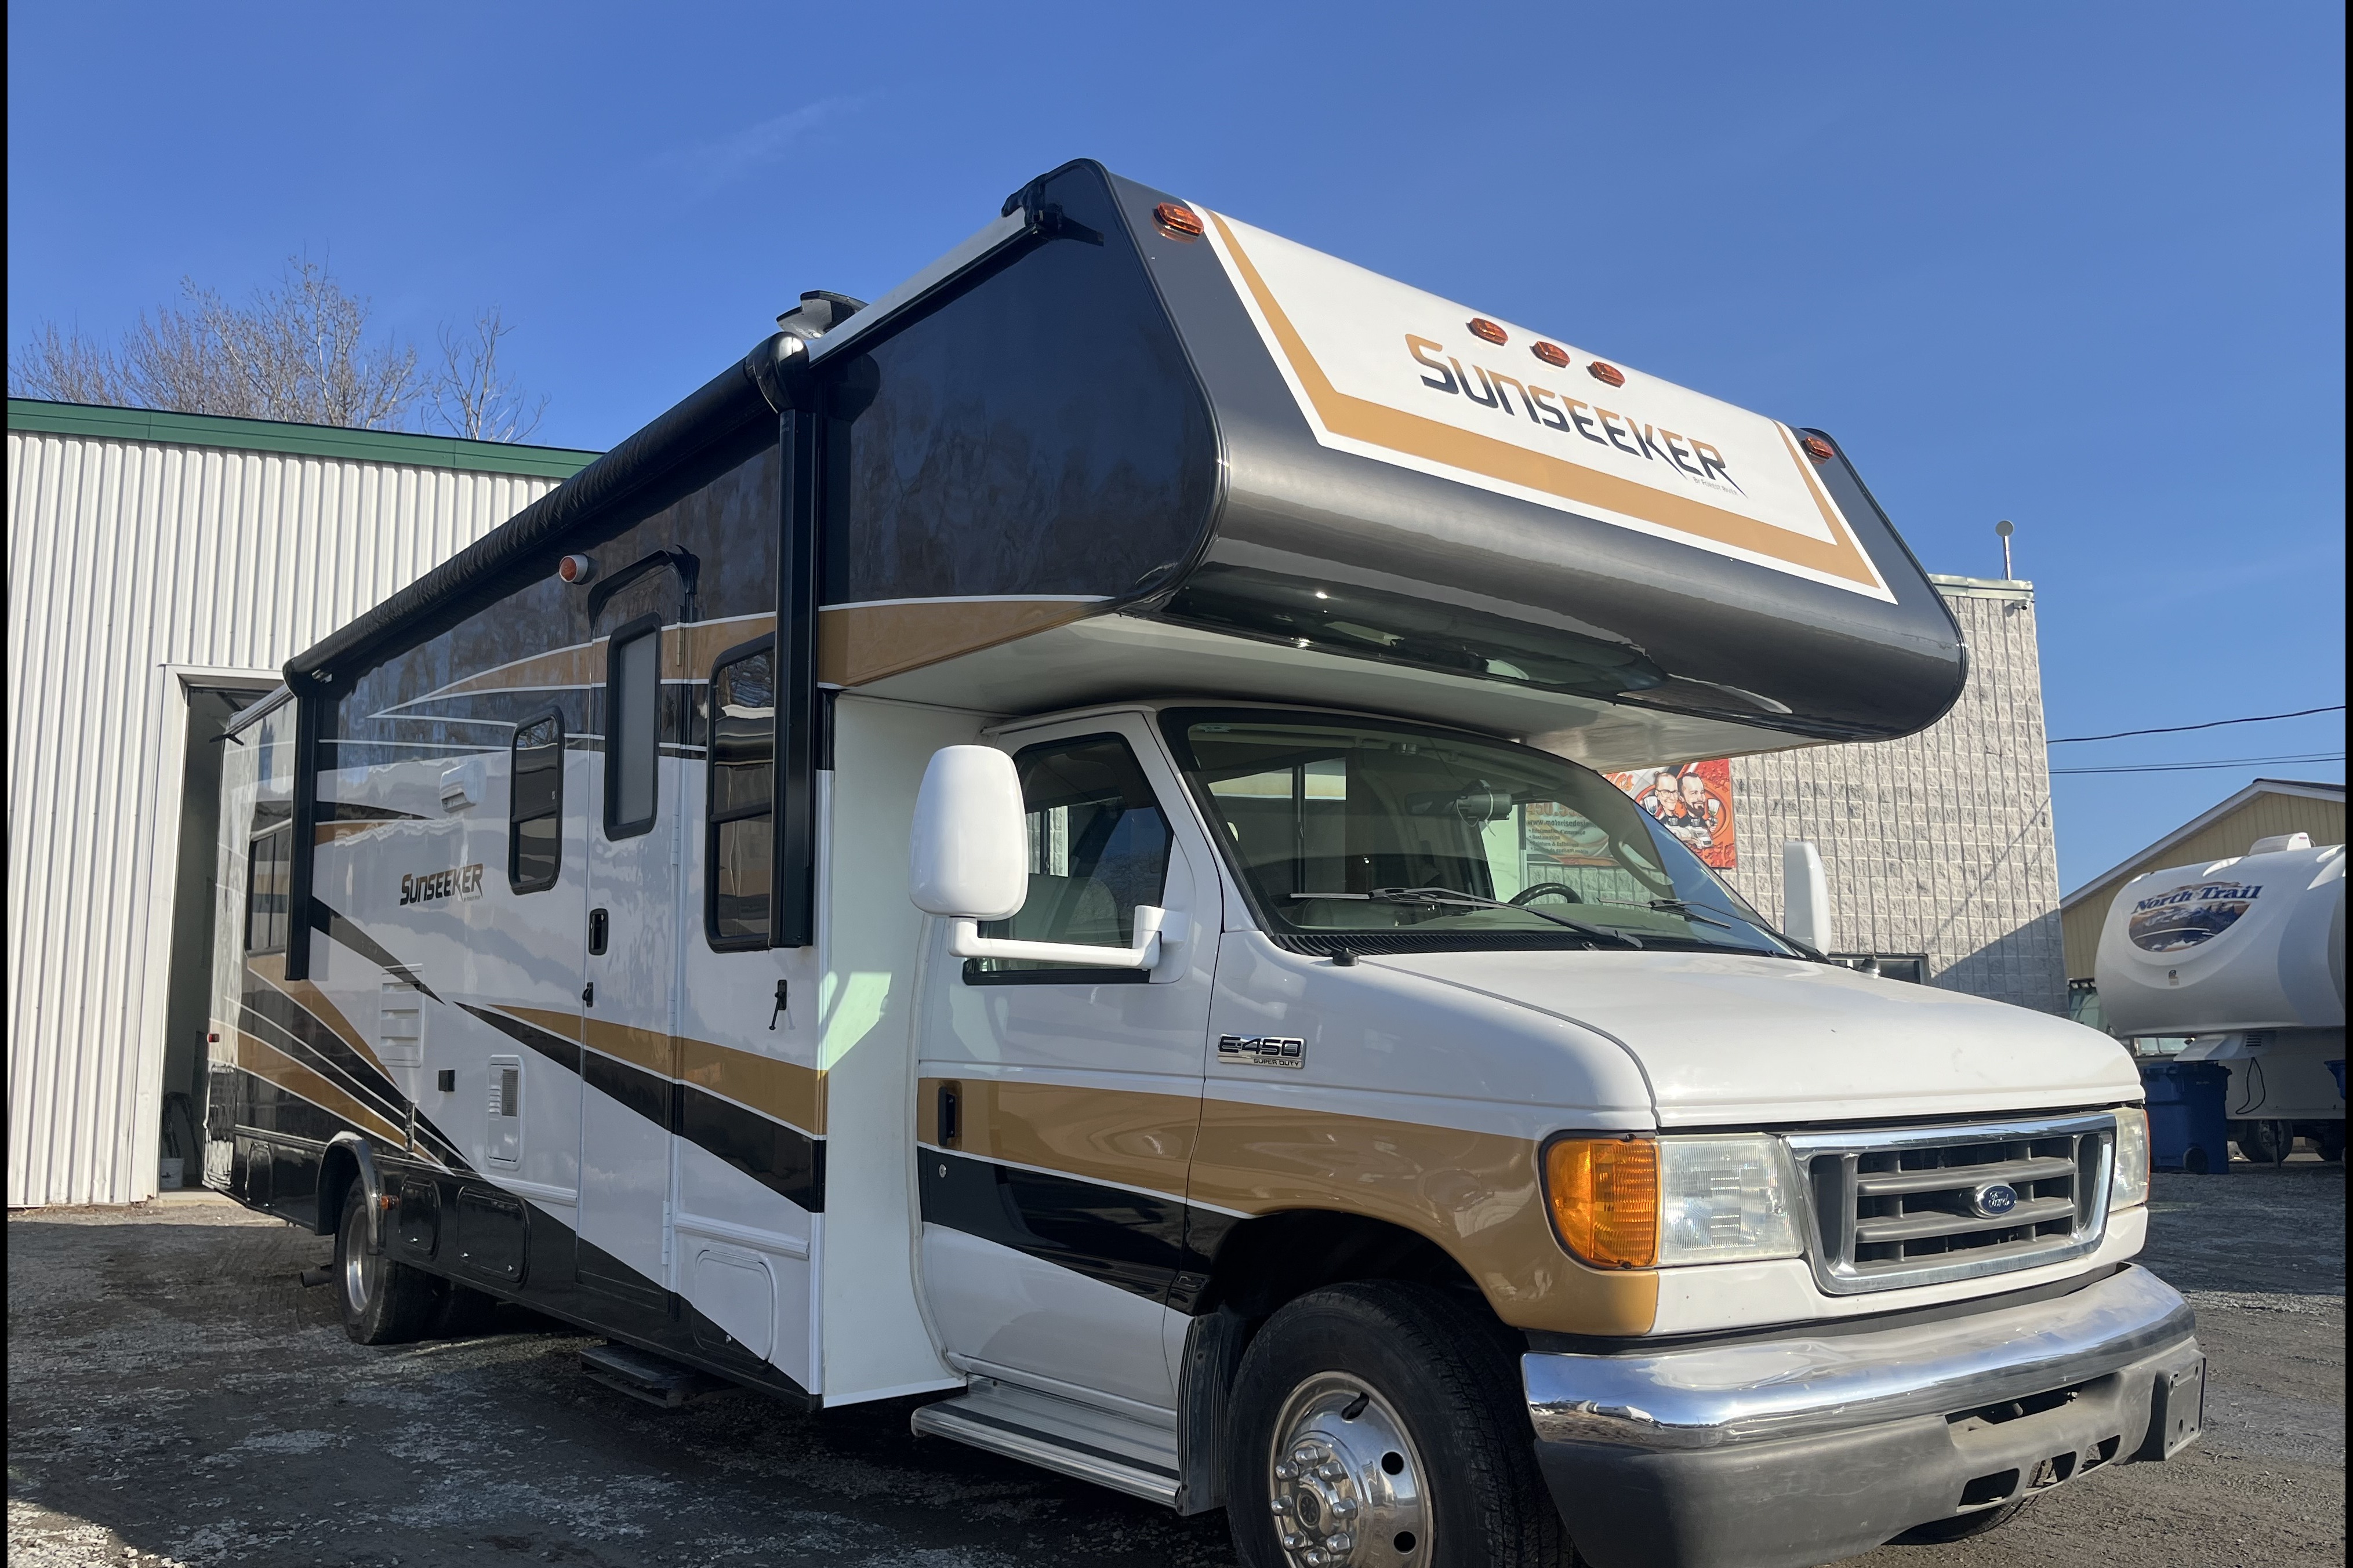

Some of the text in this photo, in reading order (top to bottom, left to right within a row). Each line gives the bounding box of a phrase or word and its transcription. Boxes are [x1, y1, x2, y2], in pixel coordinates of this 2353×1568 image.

[1405, 333, 1748, 499] SUNSEEKER
[400, 863, 483, 905] SUNSEEKER
[2131, 885, 2264, 915] North Trail
[1219, 1036, 1302, 1057] E-450
[1988, 1191, 2010, 1208] Ford
